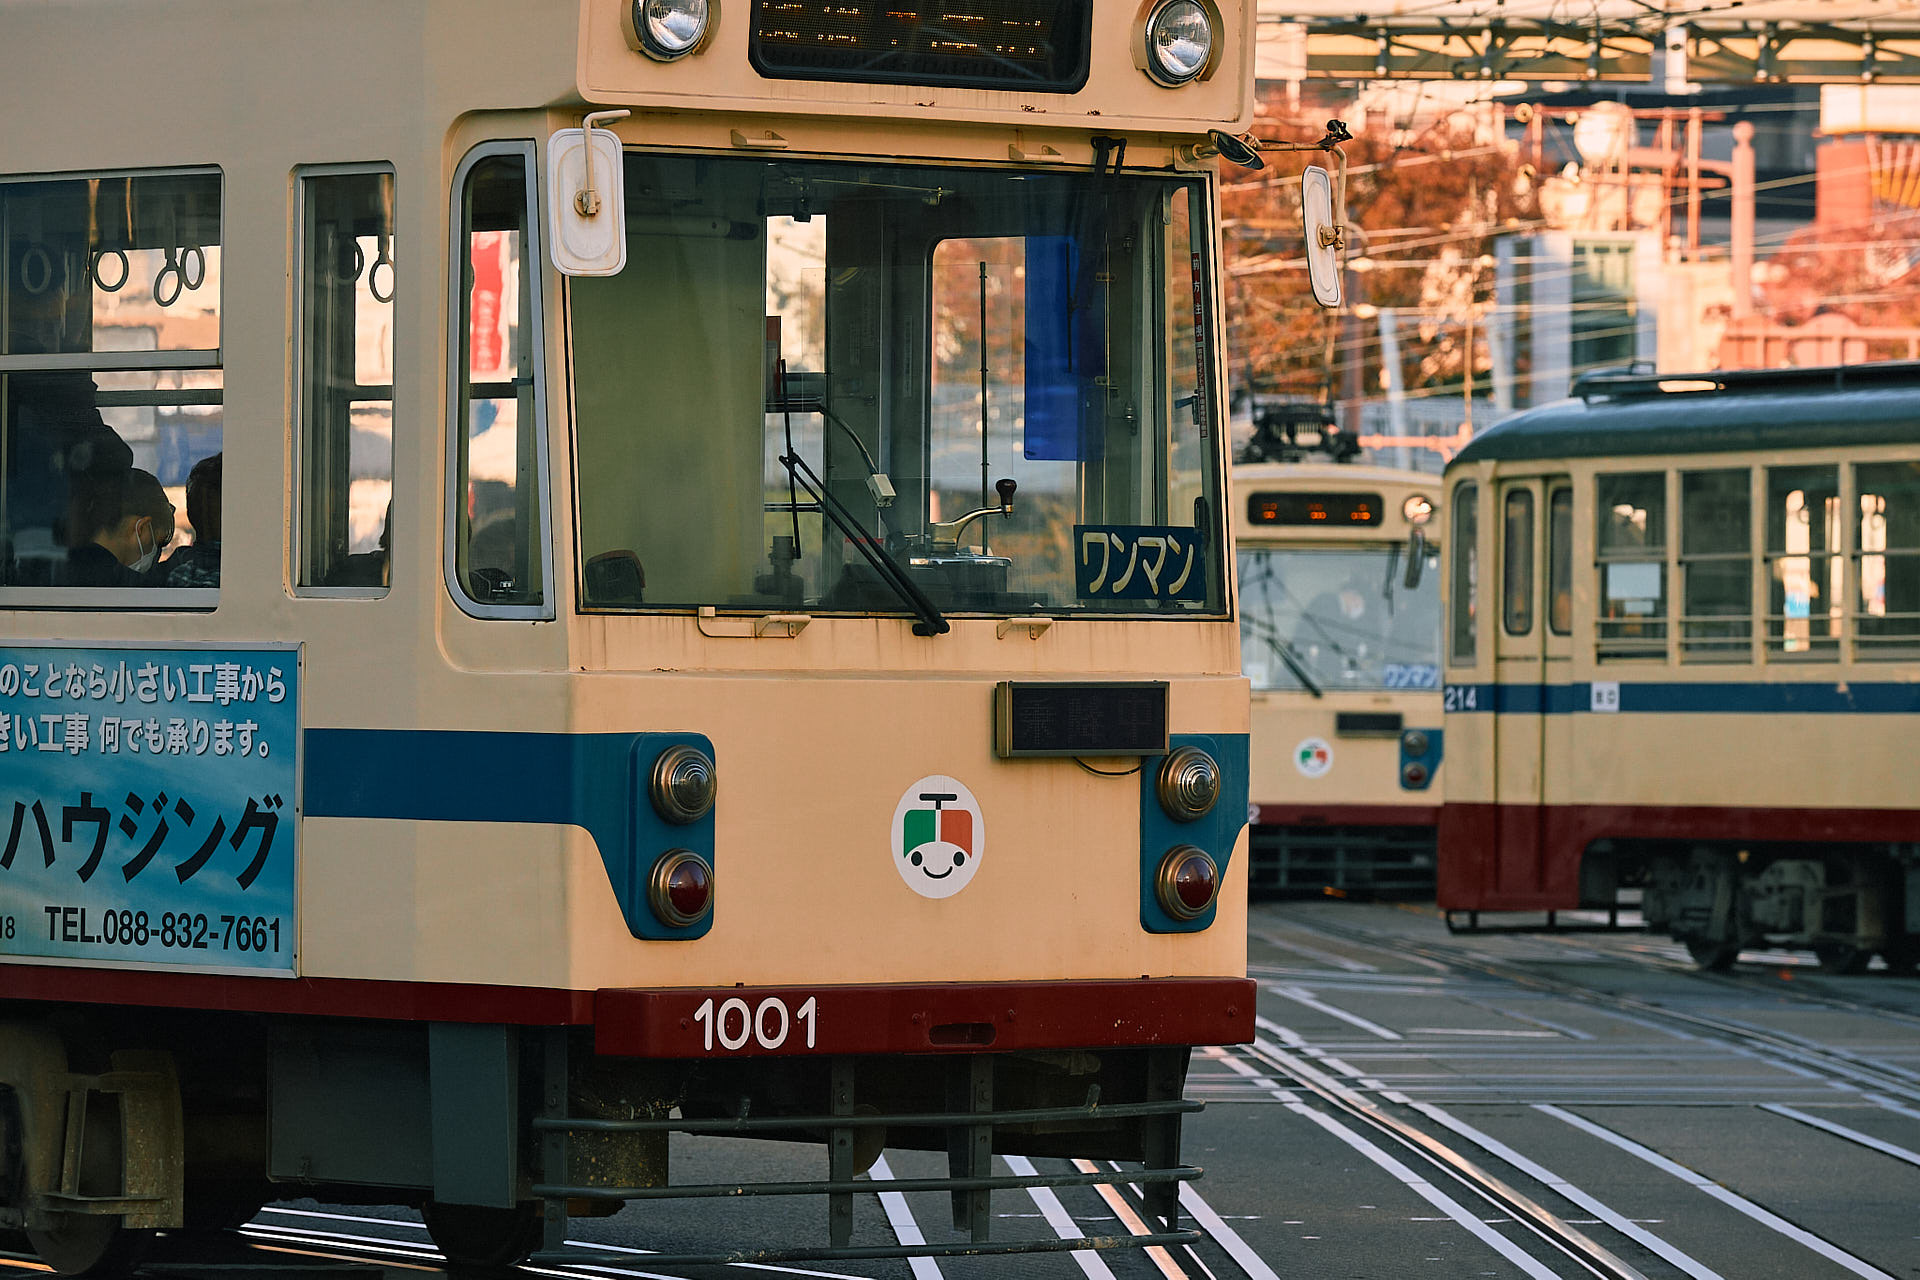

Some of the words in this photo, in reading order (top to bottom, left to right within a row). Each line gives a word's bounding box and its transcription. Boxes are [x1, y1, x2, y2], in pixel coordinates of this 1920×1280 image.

[1082, 532, 1194, 595] ワンマン
[0, 661, 287, 706] のことなら小さい工事から
[1444, 685, 1477, 711] 214
[99, 716, 269, 757] 何でも承ります。
[0, 791, 284, 891] ハウジング
[44, 906, 280, 952] TEL.088-832-7661
[694, 996, 816, 1051] 1001
